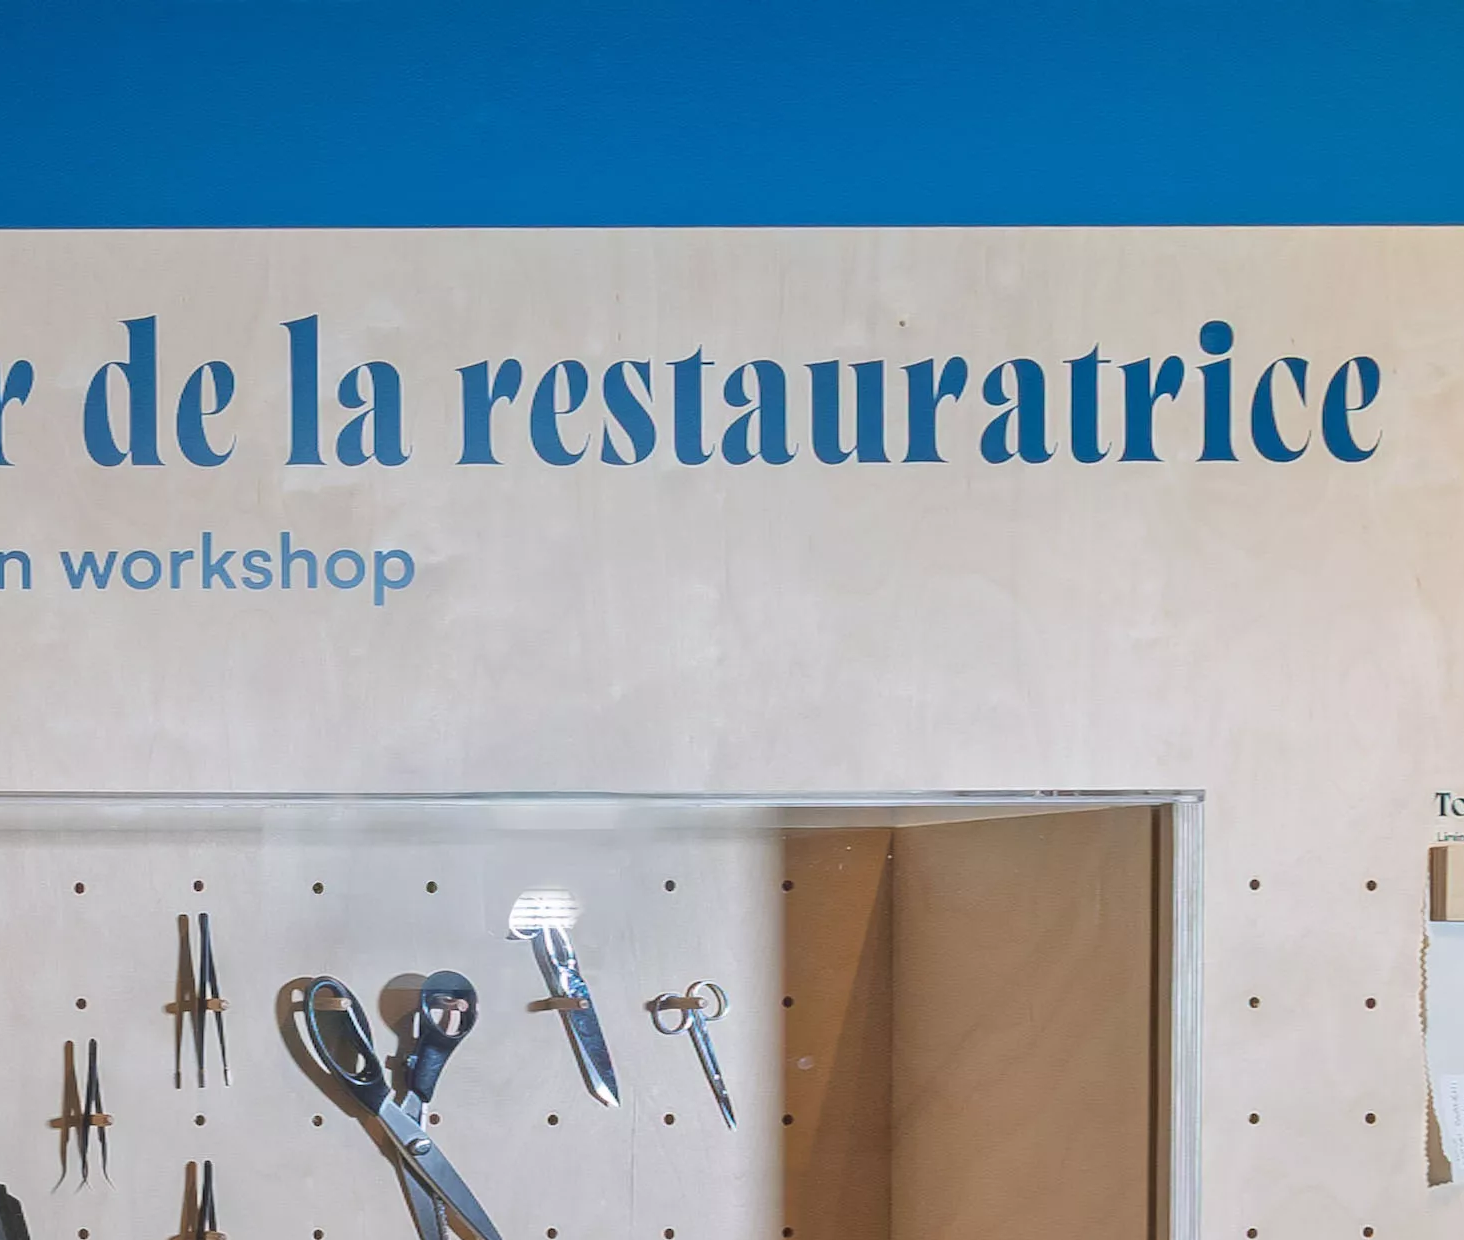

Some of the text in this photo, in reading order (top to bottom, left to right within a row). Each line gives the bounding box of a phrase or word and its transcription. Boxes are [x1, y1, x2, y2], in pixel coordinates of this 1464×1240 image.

[81, 315, 238, 470] de
[281, 314, 413, 469] la
[455, 319, 1383, 467] restauratrice
[61, 531, 415, 607] workshop
